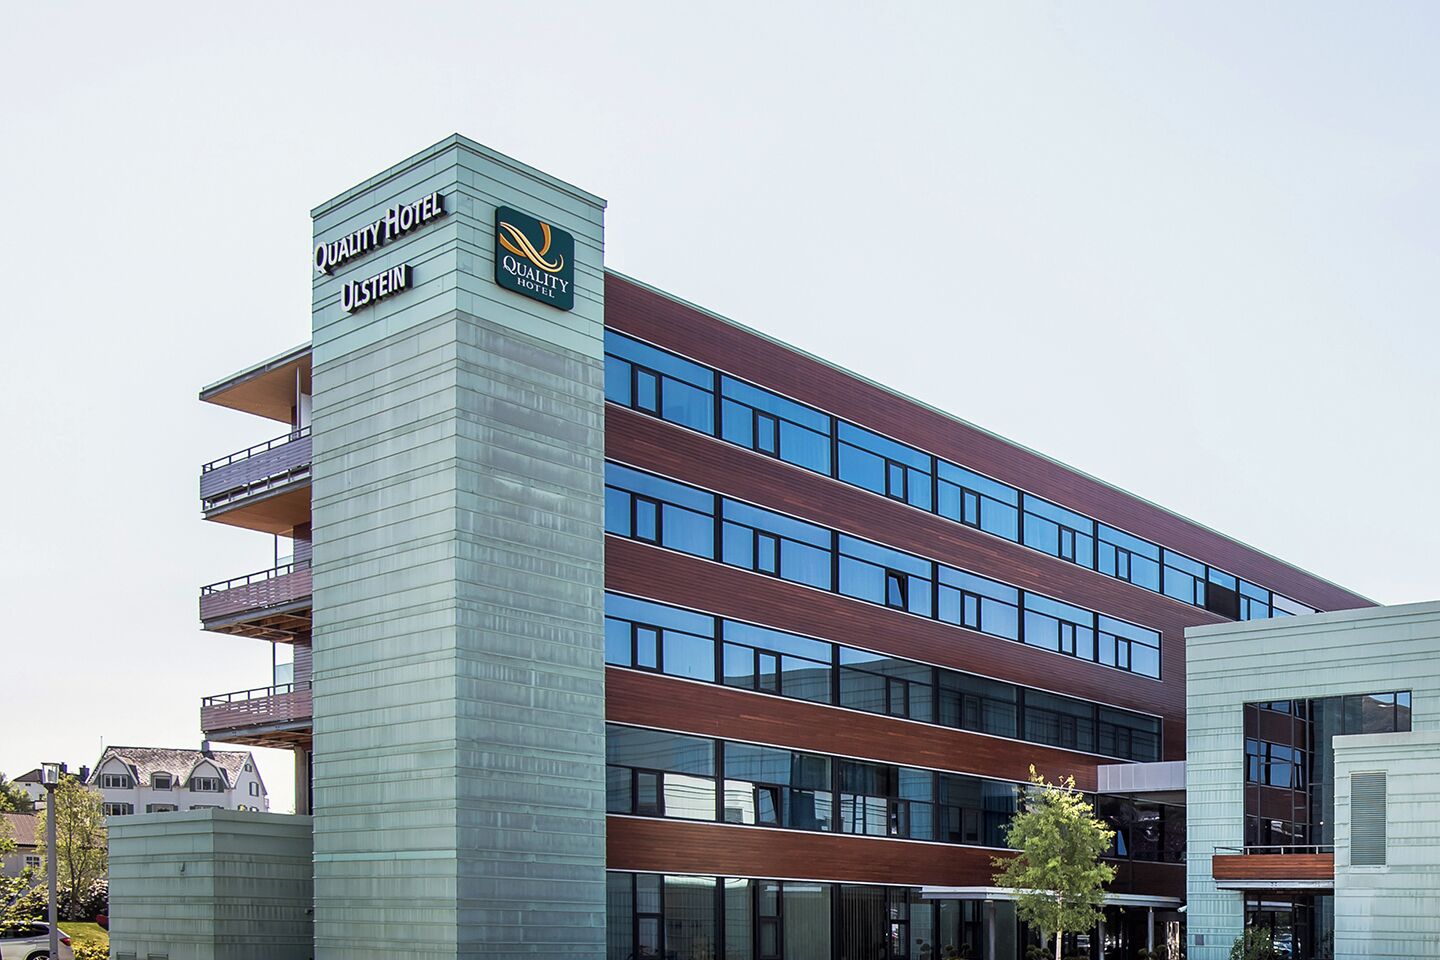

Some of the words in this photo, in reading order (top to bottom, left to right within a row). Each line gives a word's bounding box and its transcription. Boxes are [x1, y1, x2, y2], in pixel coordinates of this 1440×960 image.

[314, 219, 382, 275] QUALITY
[384, 192, 442, 241] HOTEL
[340, 264, 409, 312] ULSTEIN
[503, 255, 569, 294] QUALITY
[517, 277, 555, 299] HOTEL
